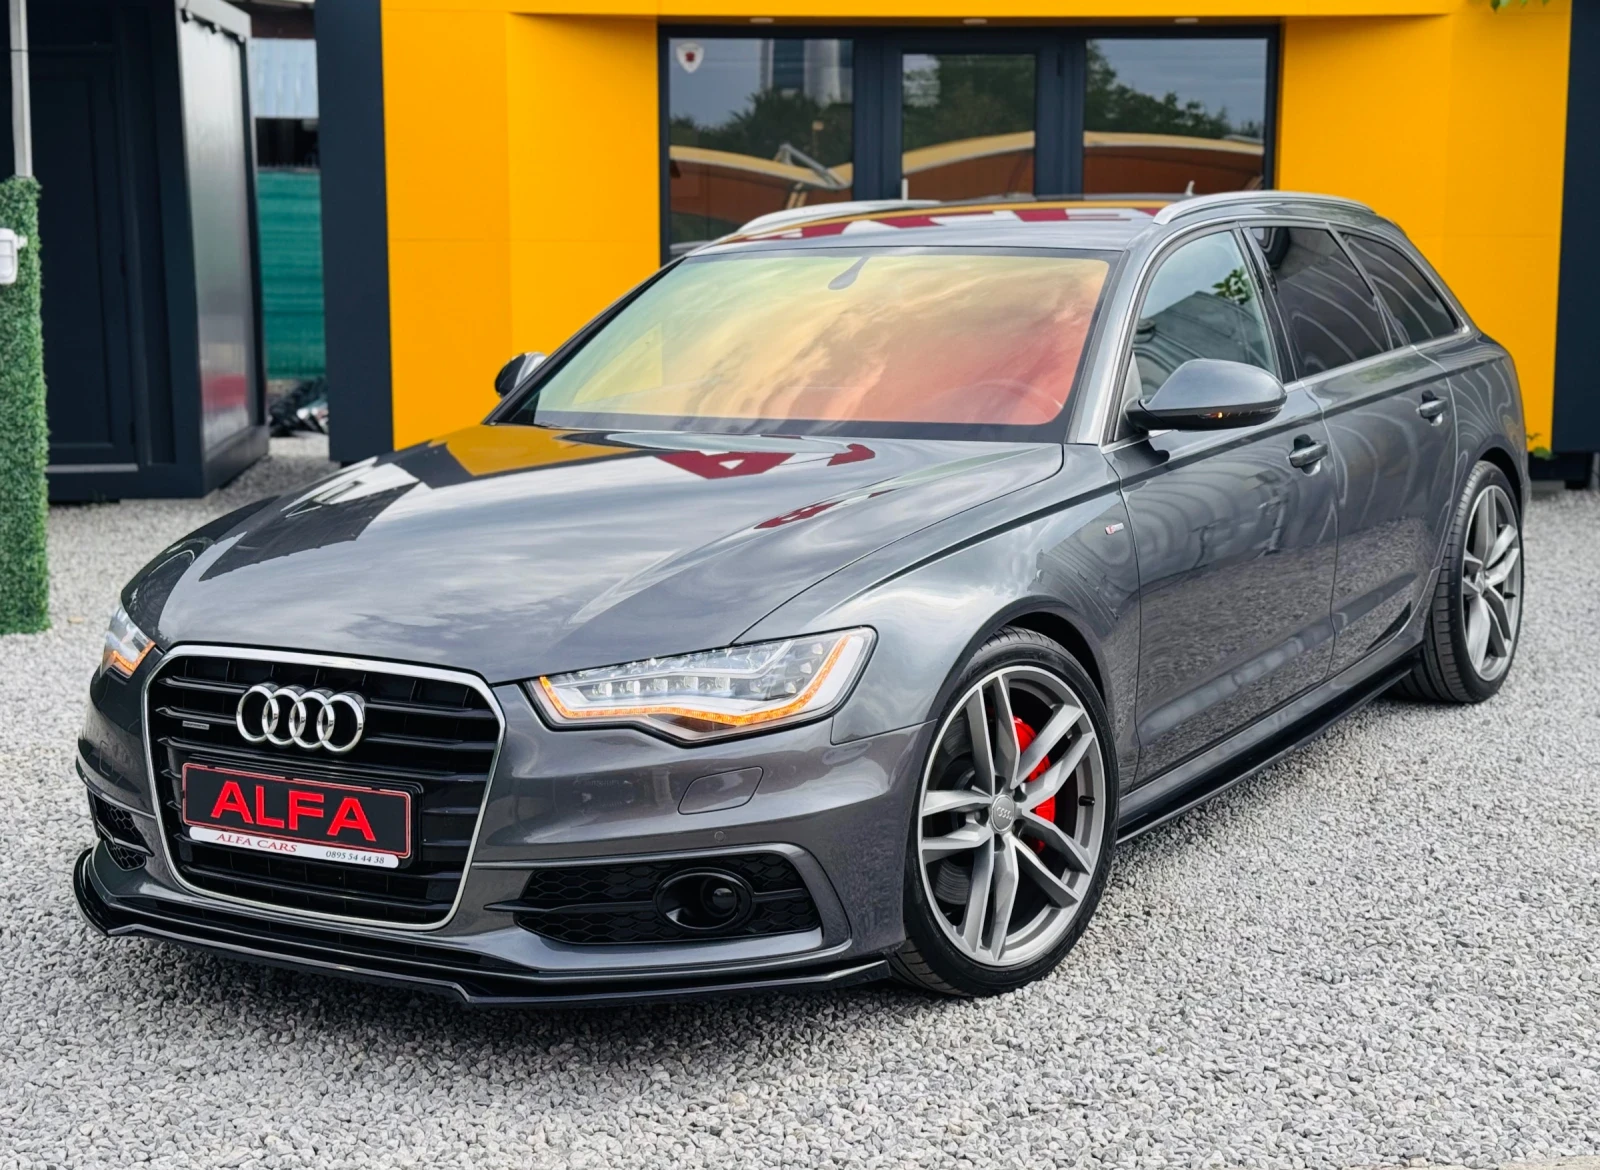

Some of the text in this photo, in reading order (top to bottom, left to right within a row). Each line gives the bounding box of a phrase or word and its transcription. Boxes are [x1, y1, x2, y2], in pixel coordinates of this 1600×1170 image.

[210, 780, 377, 842] ALFA
[215, 833, 298, 853] ALFA CARS
[325, 850, 385, 865] 0895 54 44 38
